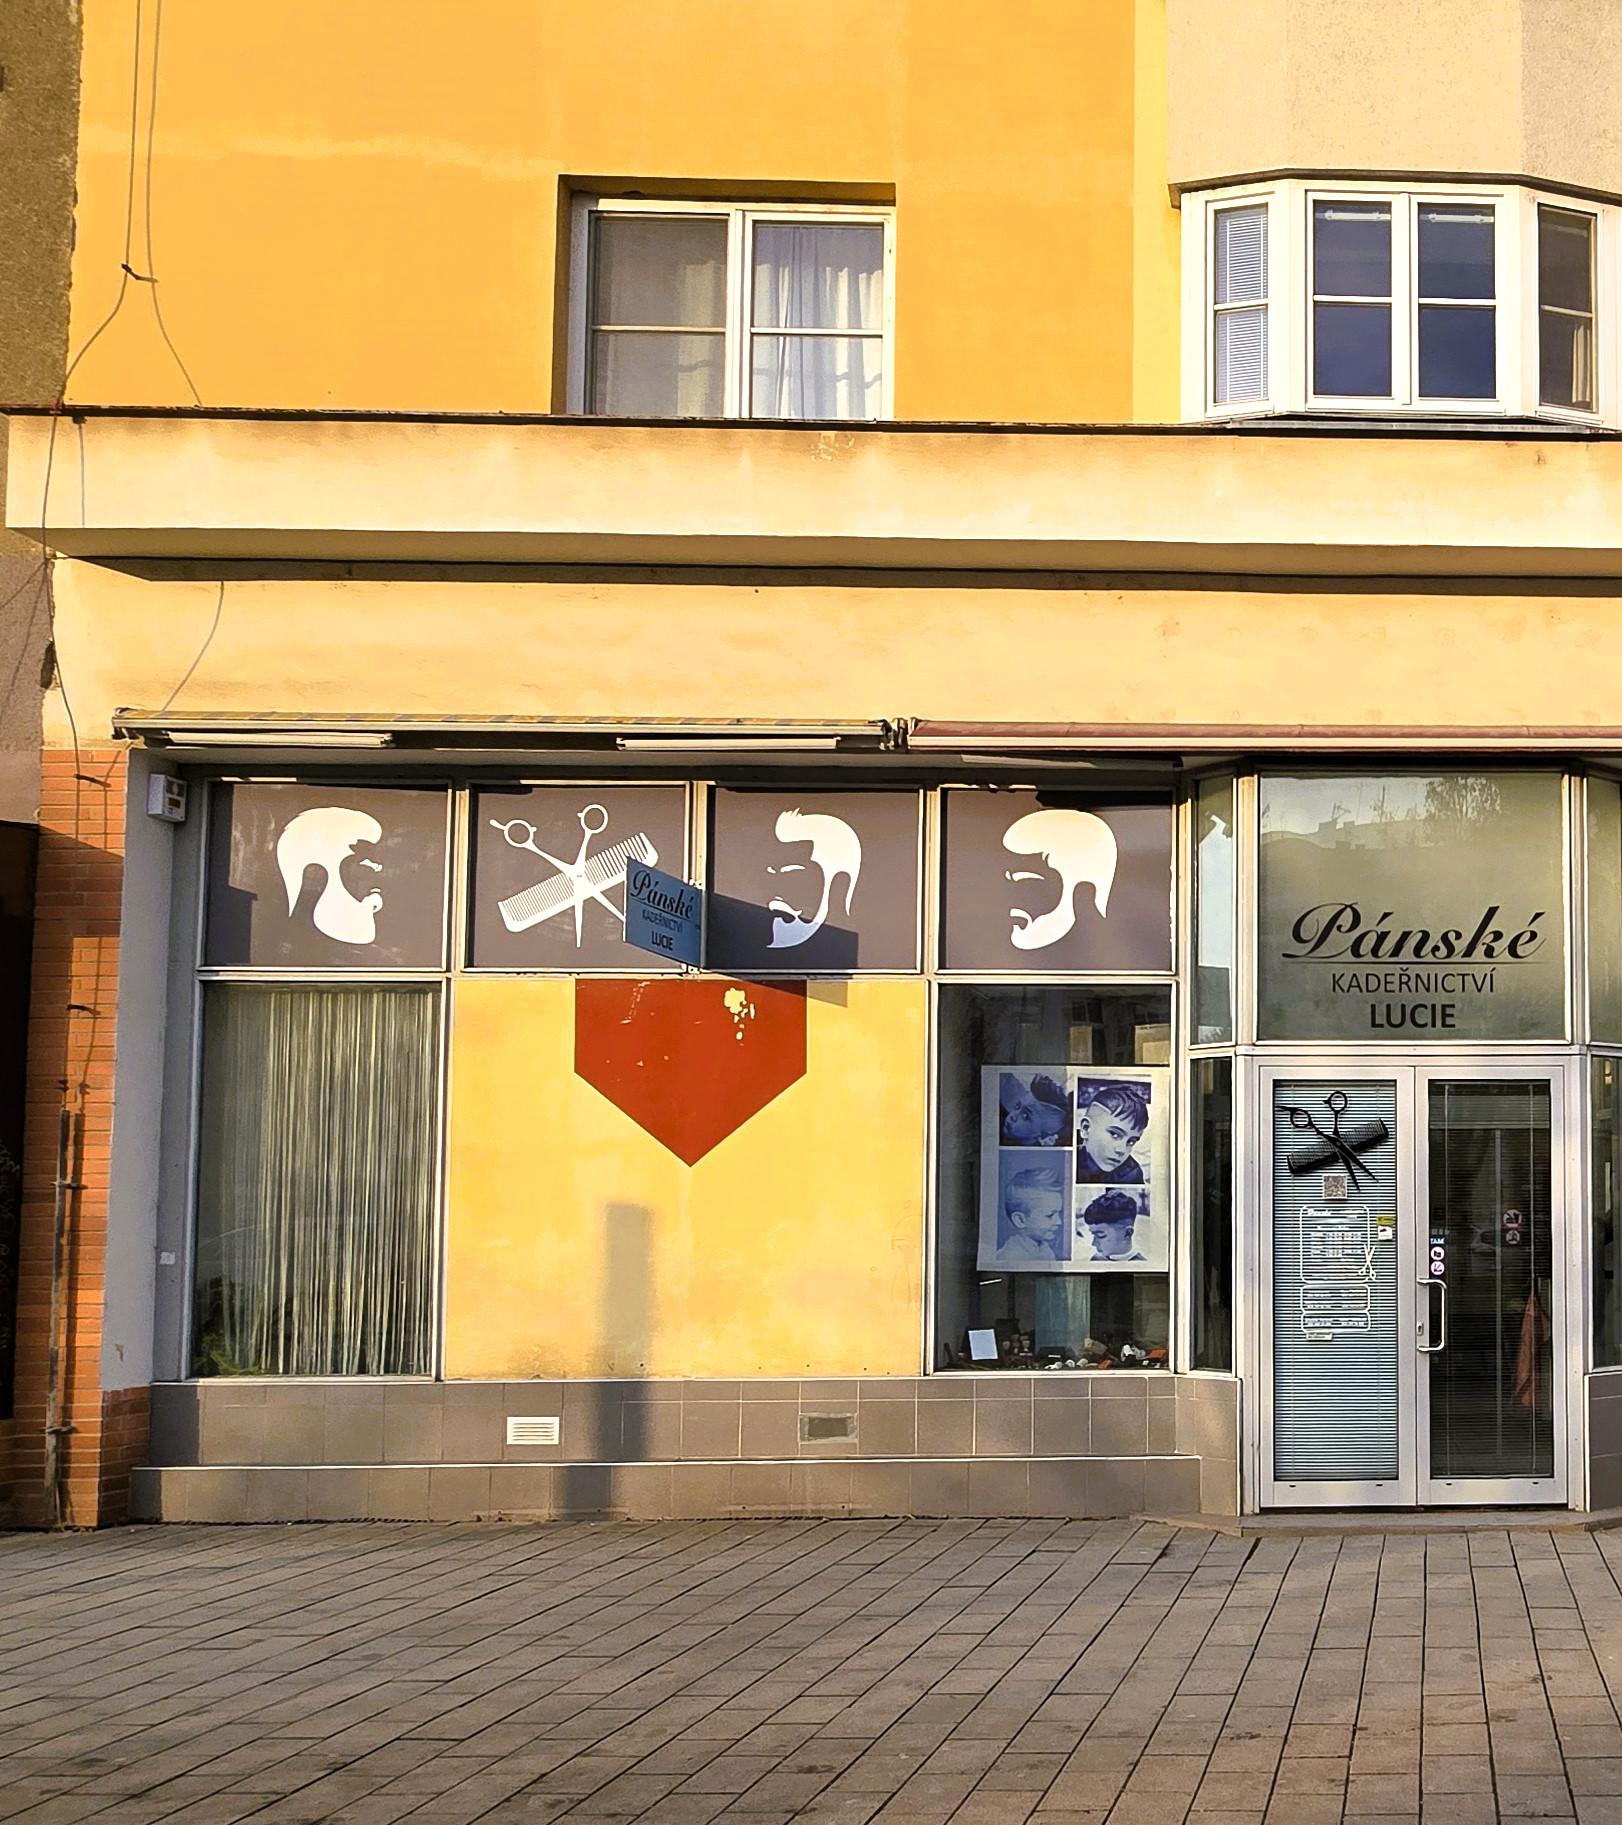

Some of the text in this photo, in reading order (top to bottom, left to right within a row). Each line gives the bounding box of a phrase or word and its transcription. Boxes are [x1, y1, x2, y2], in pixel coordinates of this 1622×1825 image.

[630, 869, 694, 919] Pánské
[1281, 902, 1546, 959] Pánské
[1331, 968, 1497, 994] KADEŘNICTVÍ
[1370, 1003, 1456, 1029] LUCIE
